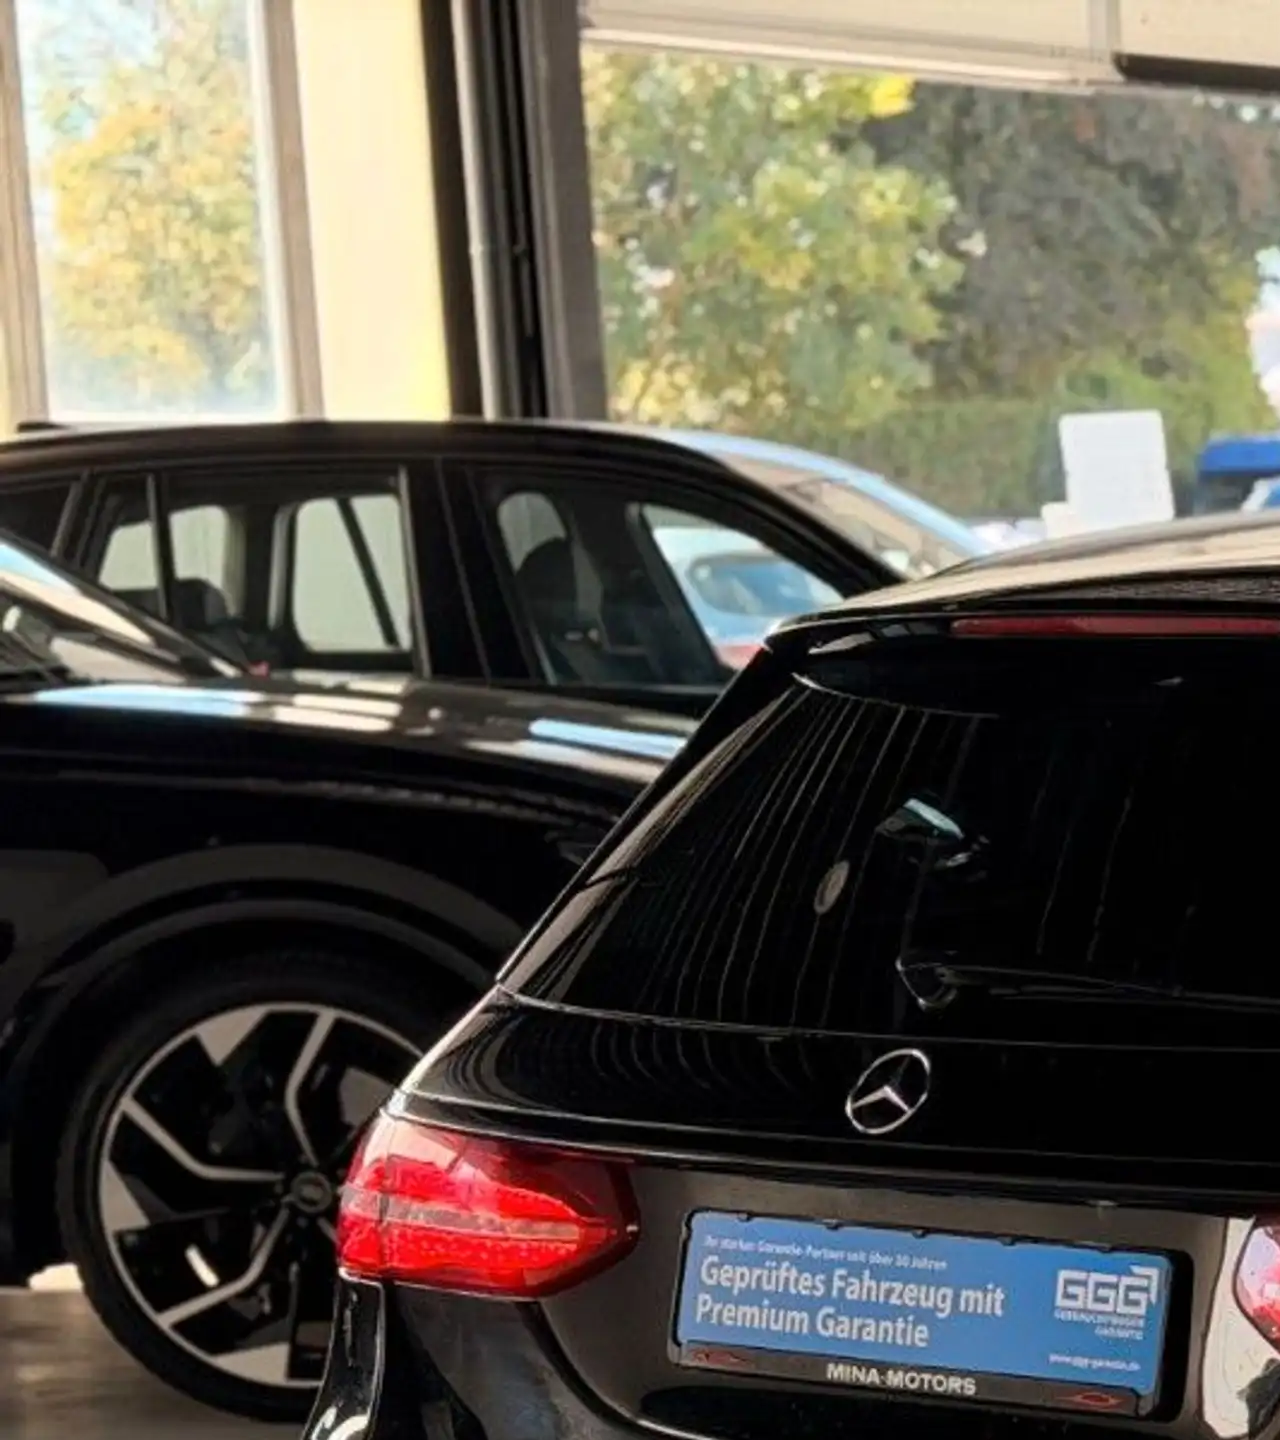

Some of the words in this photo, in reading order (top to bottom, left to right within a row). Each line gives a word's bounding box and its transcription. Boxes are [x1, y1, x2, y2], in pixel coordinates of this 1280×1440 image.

[700, 1255, 826, 1298] Geprüftes
[831, 1268, 954, 1319] Fahrzeug
[958, 1284, 1006, 1317] mit
[1055, 1266, 1156, 1315] GGG
[696, 1293, 809, 1335] Premium
[816, 1306, 929, 1348] Garantie
